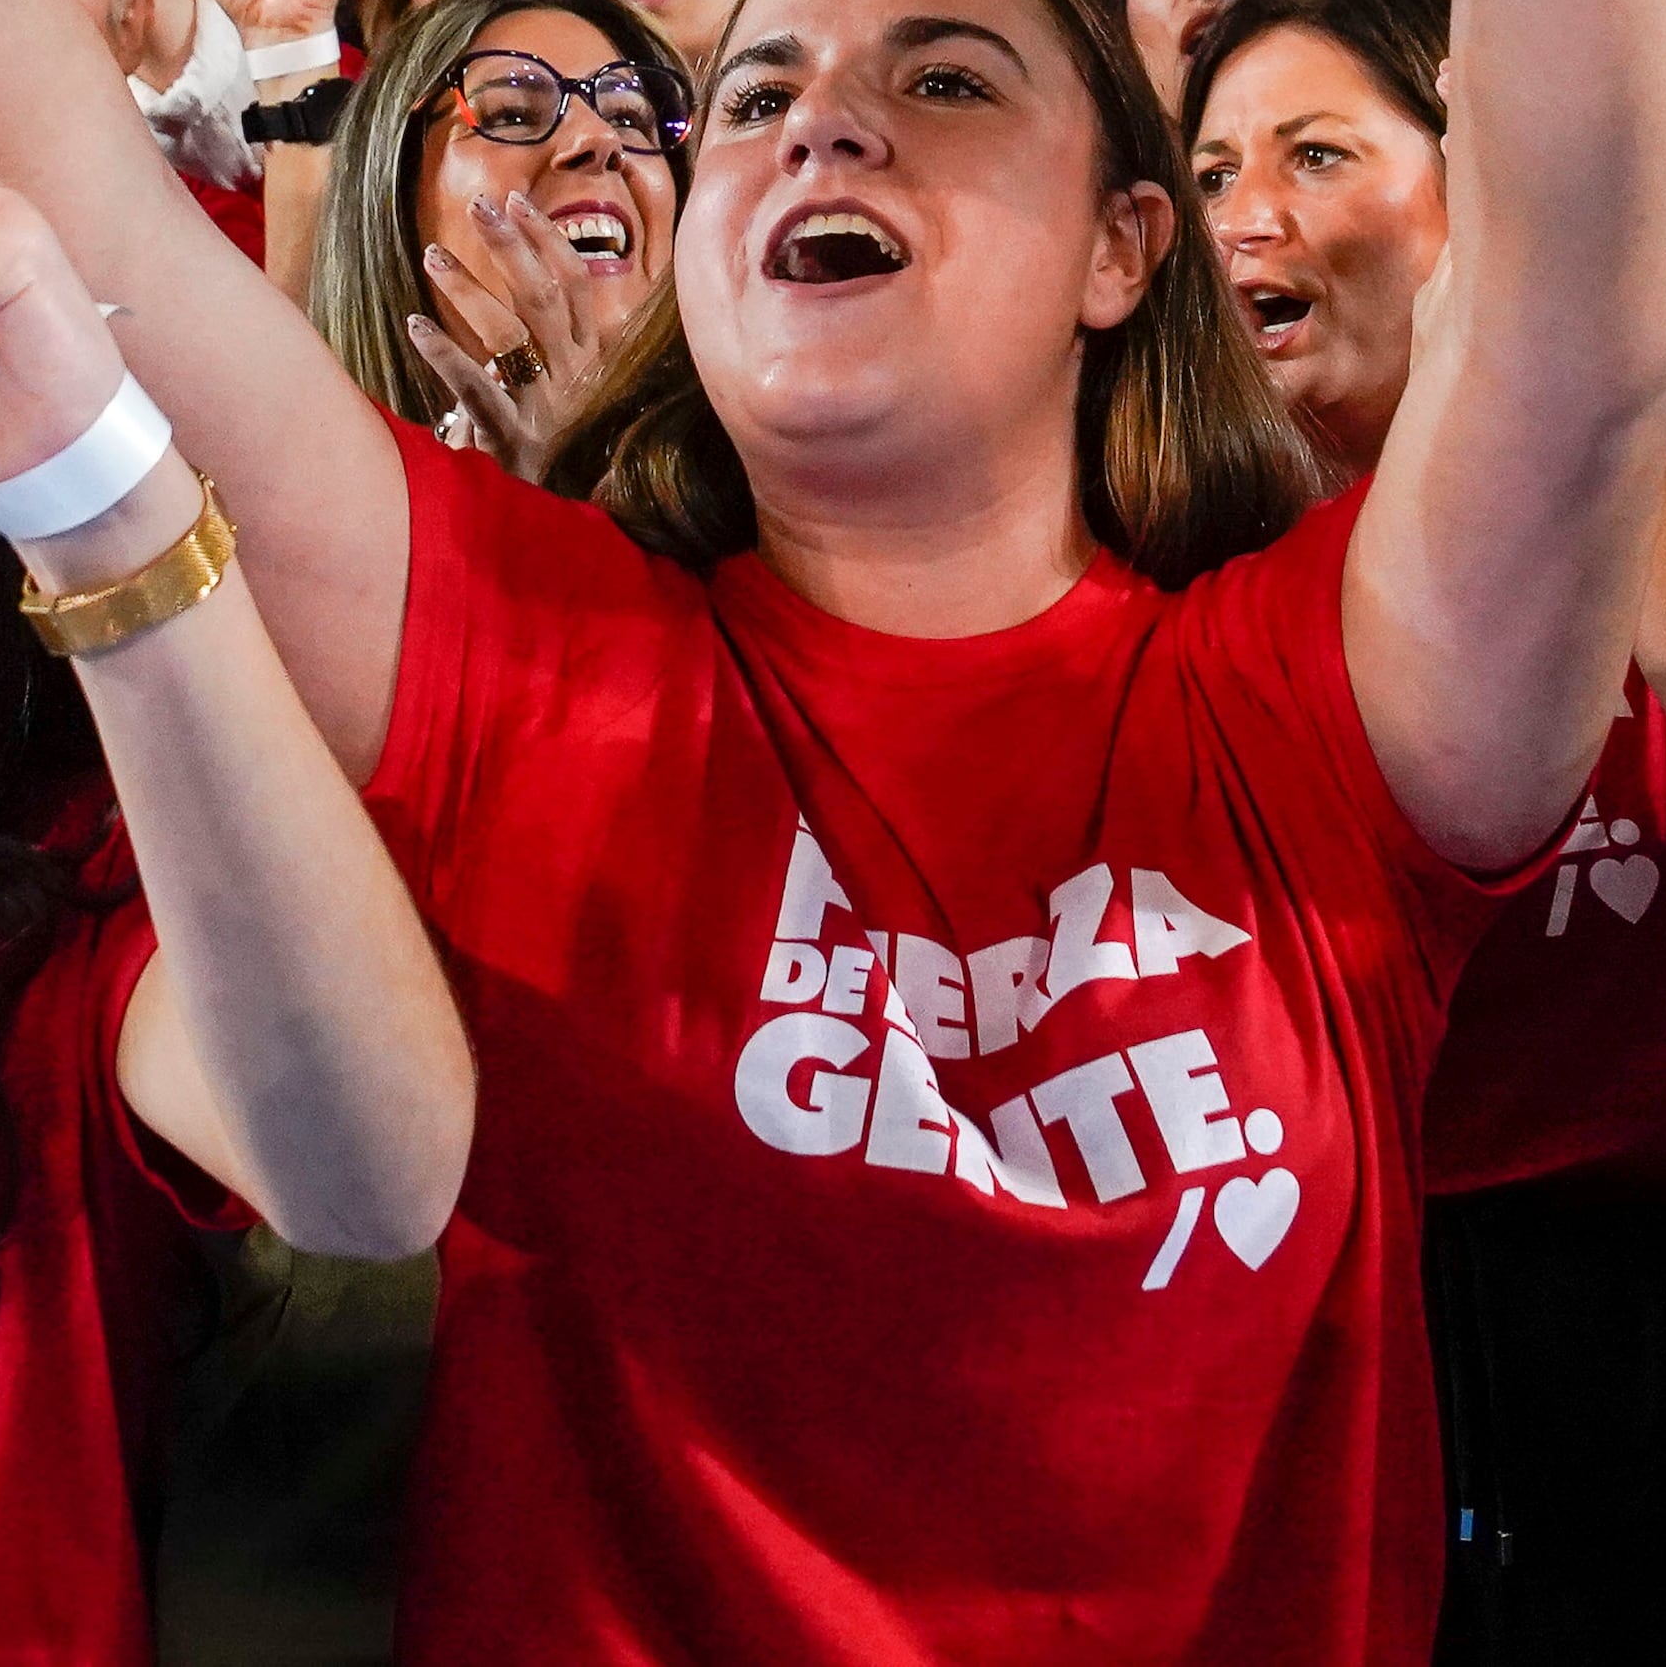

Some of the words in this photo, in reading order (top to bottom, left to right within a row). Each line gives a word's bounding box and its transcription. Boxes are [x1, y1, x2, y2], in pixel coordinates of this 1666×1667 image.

[759, 940, 876, 1016] DE
[774, 830, 1253, 1061] FERZA
[733, 1011, 1284, 1211] GENTE.
